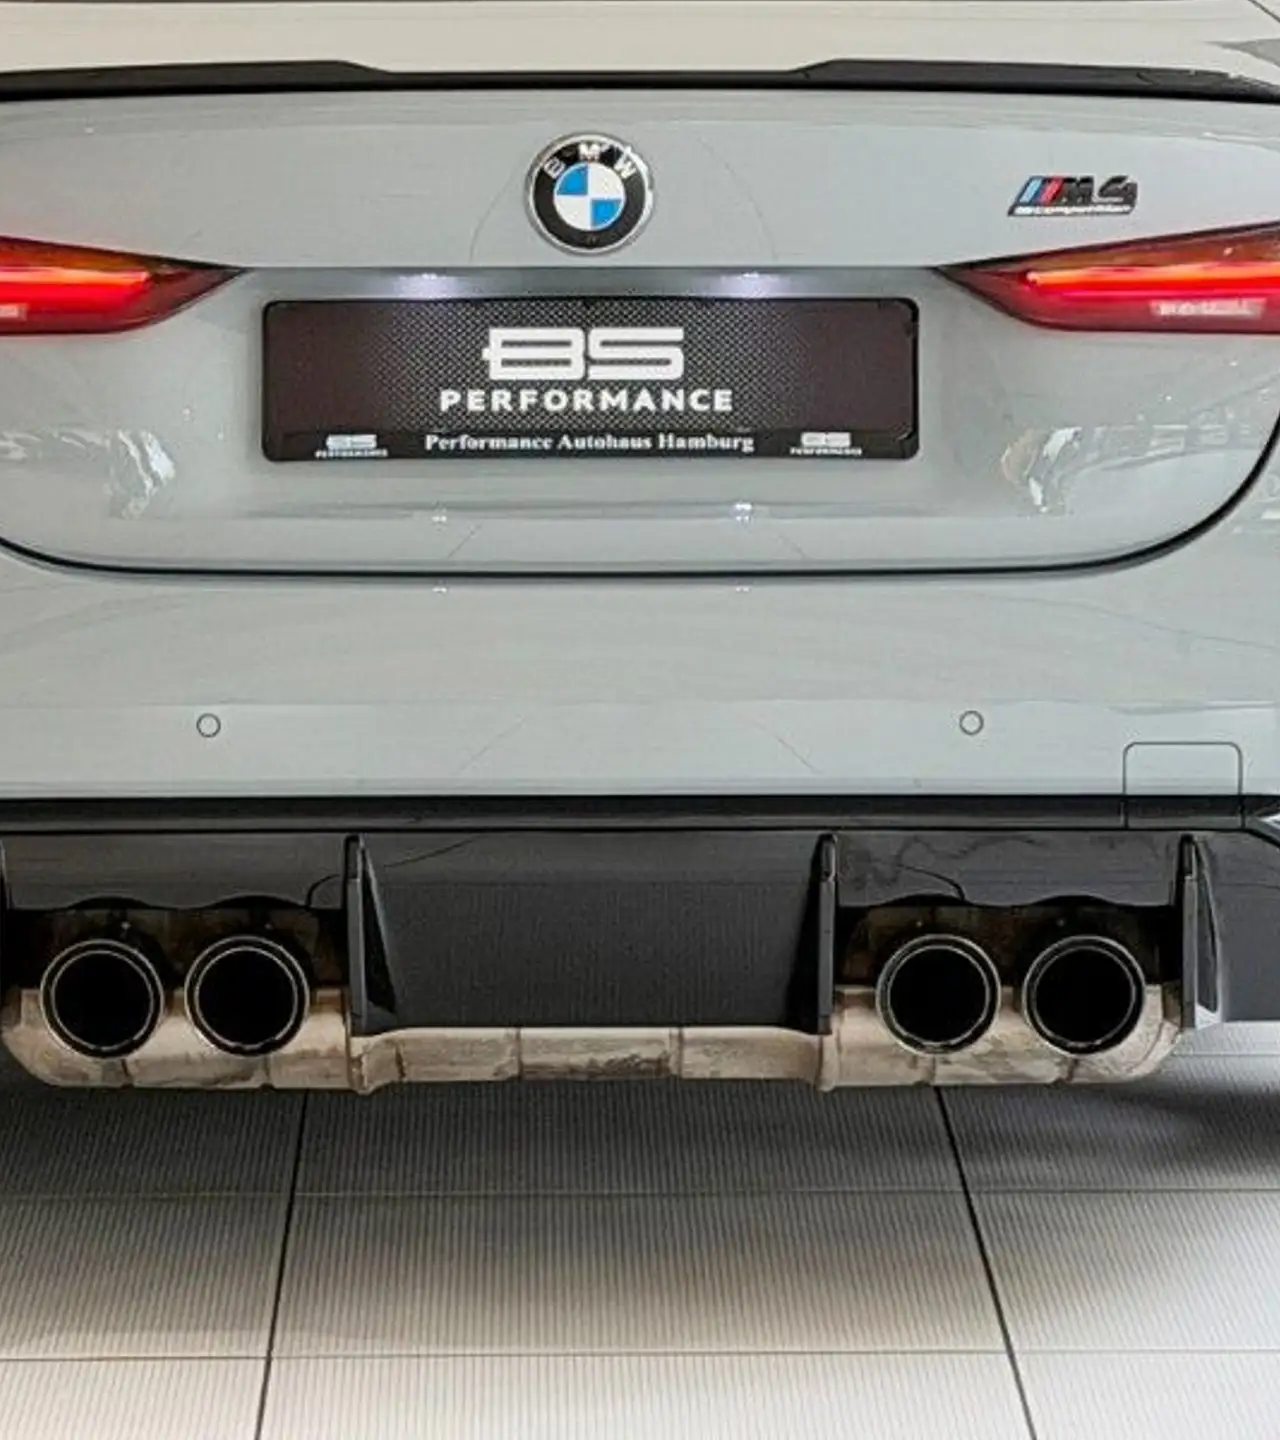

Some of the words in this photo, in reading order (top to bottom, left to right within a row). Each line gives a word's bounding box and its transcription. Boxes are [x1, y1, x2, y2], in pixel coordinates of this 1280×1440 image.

[543, 143, 637, 180] BMW
[482, 327, 684, 381] BS
[440, 389, 733, 413] PERFORMANCE
[425, 434, 554, 451] Performance
[557, 434, 653, 450] Autohaus
[658, 433, 755, 453] Hamburg
